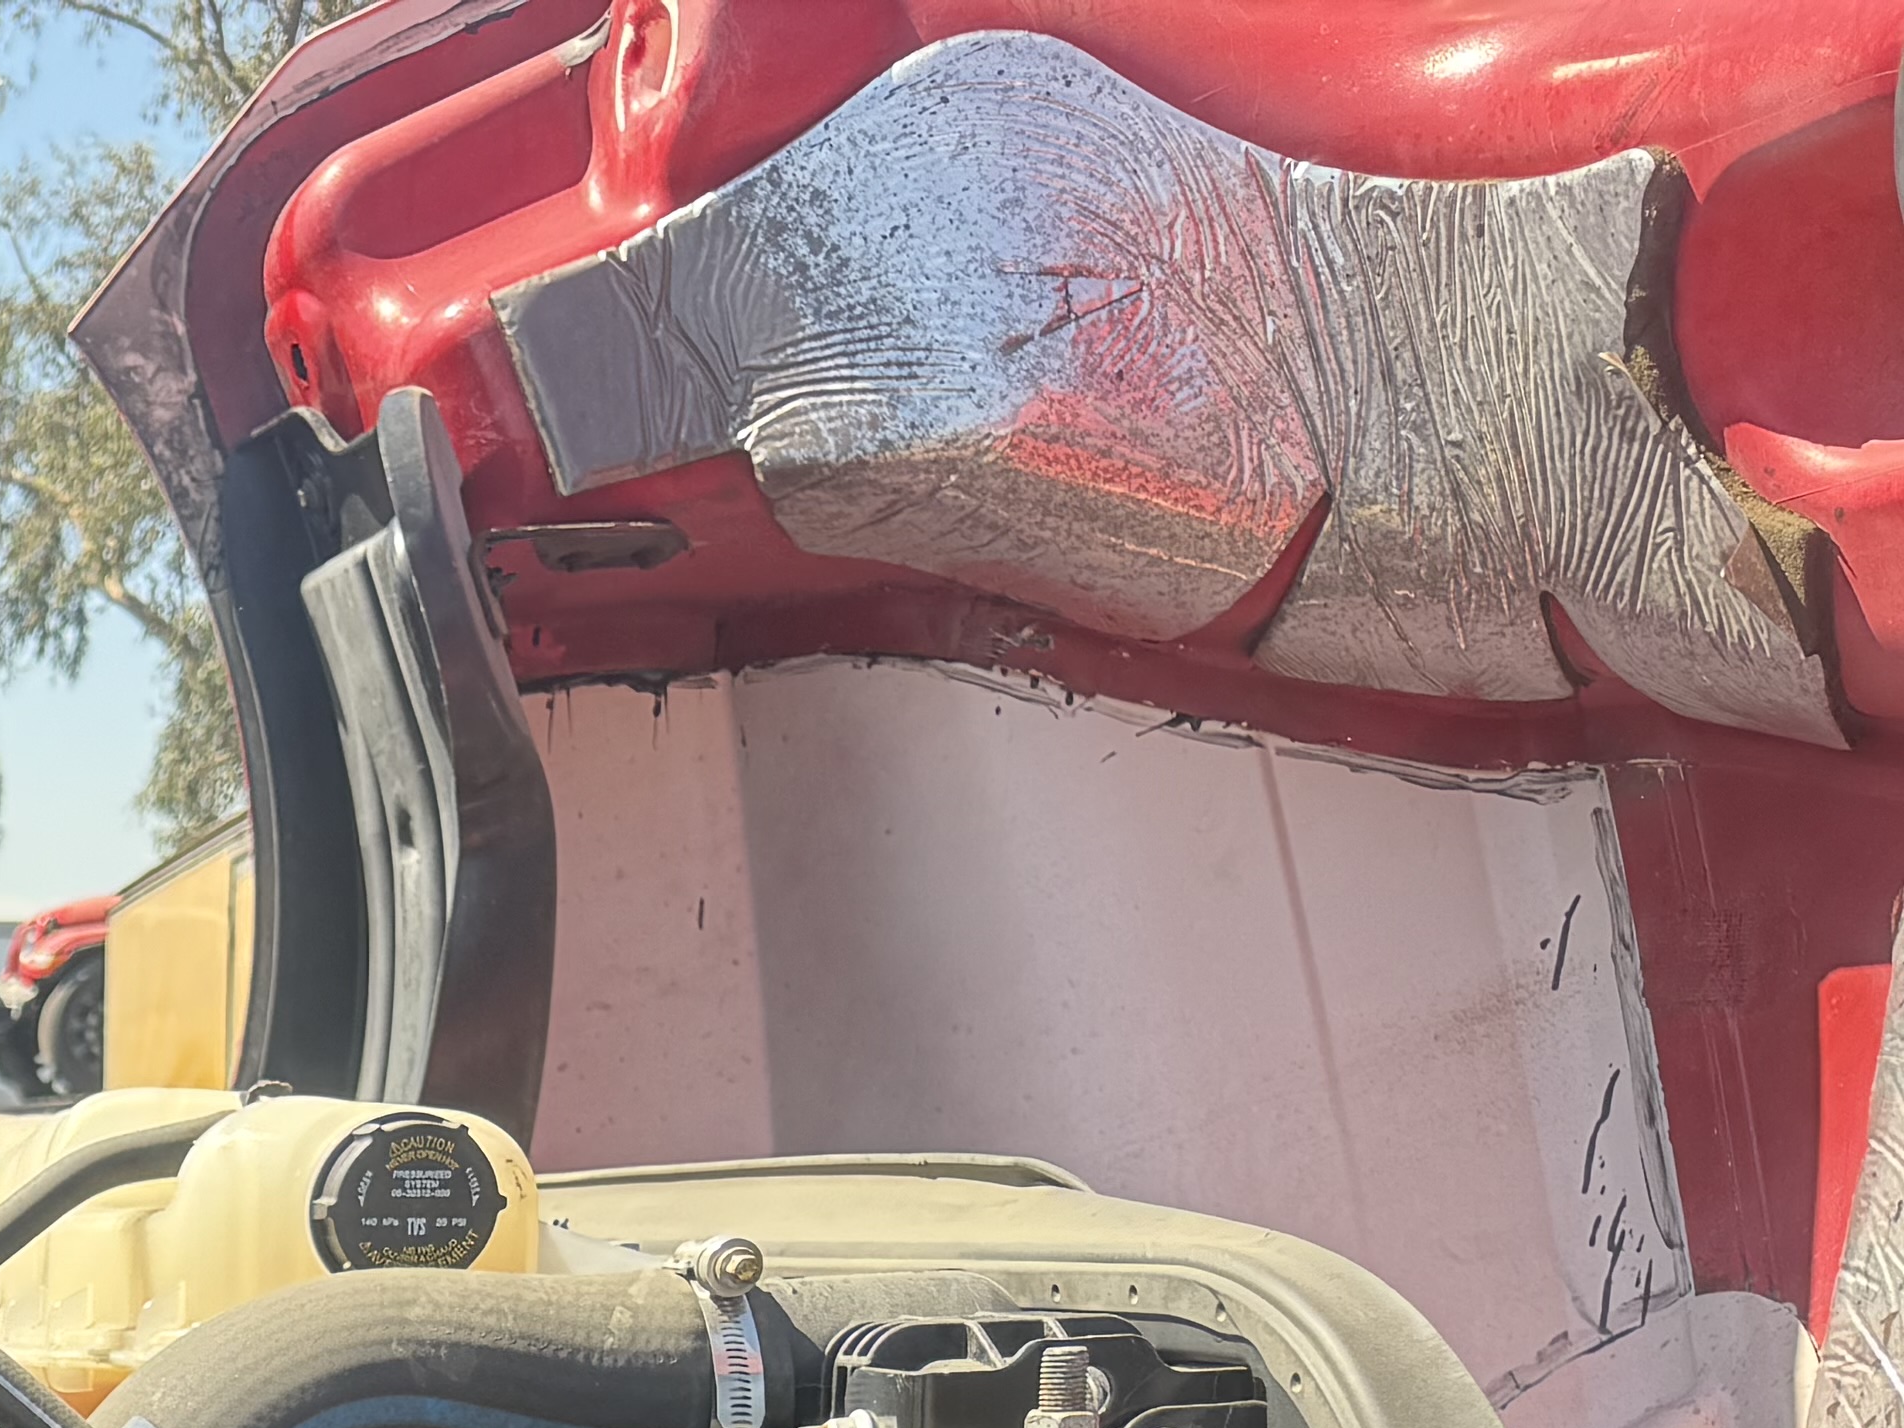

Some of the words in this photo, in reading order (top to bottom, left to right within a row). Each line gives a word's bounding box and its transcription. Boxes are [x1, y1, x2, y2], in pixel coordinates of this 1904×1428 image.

[401, 1135, 455, 1153] CAUTION
[404, 1180, 439, 1188] SYSTEM
[406, 1217, 427, 1236] TVS
[452, 1217, 467, 1226] PSI
